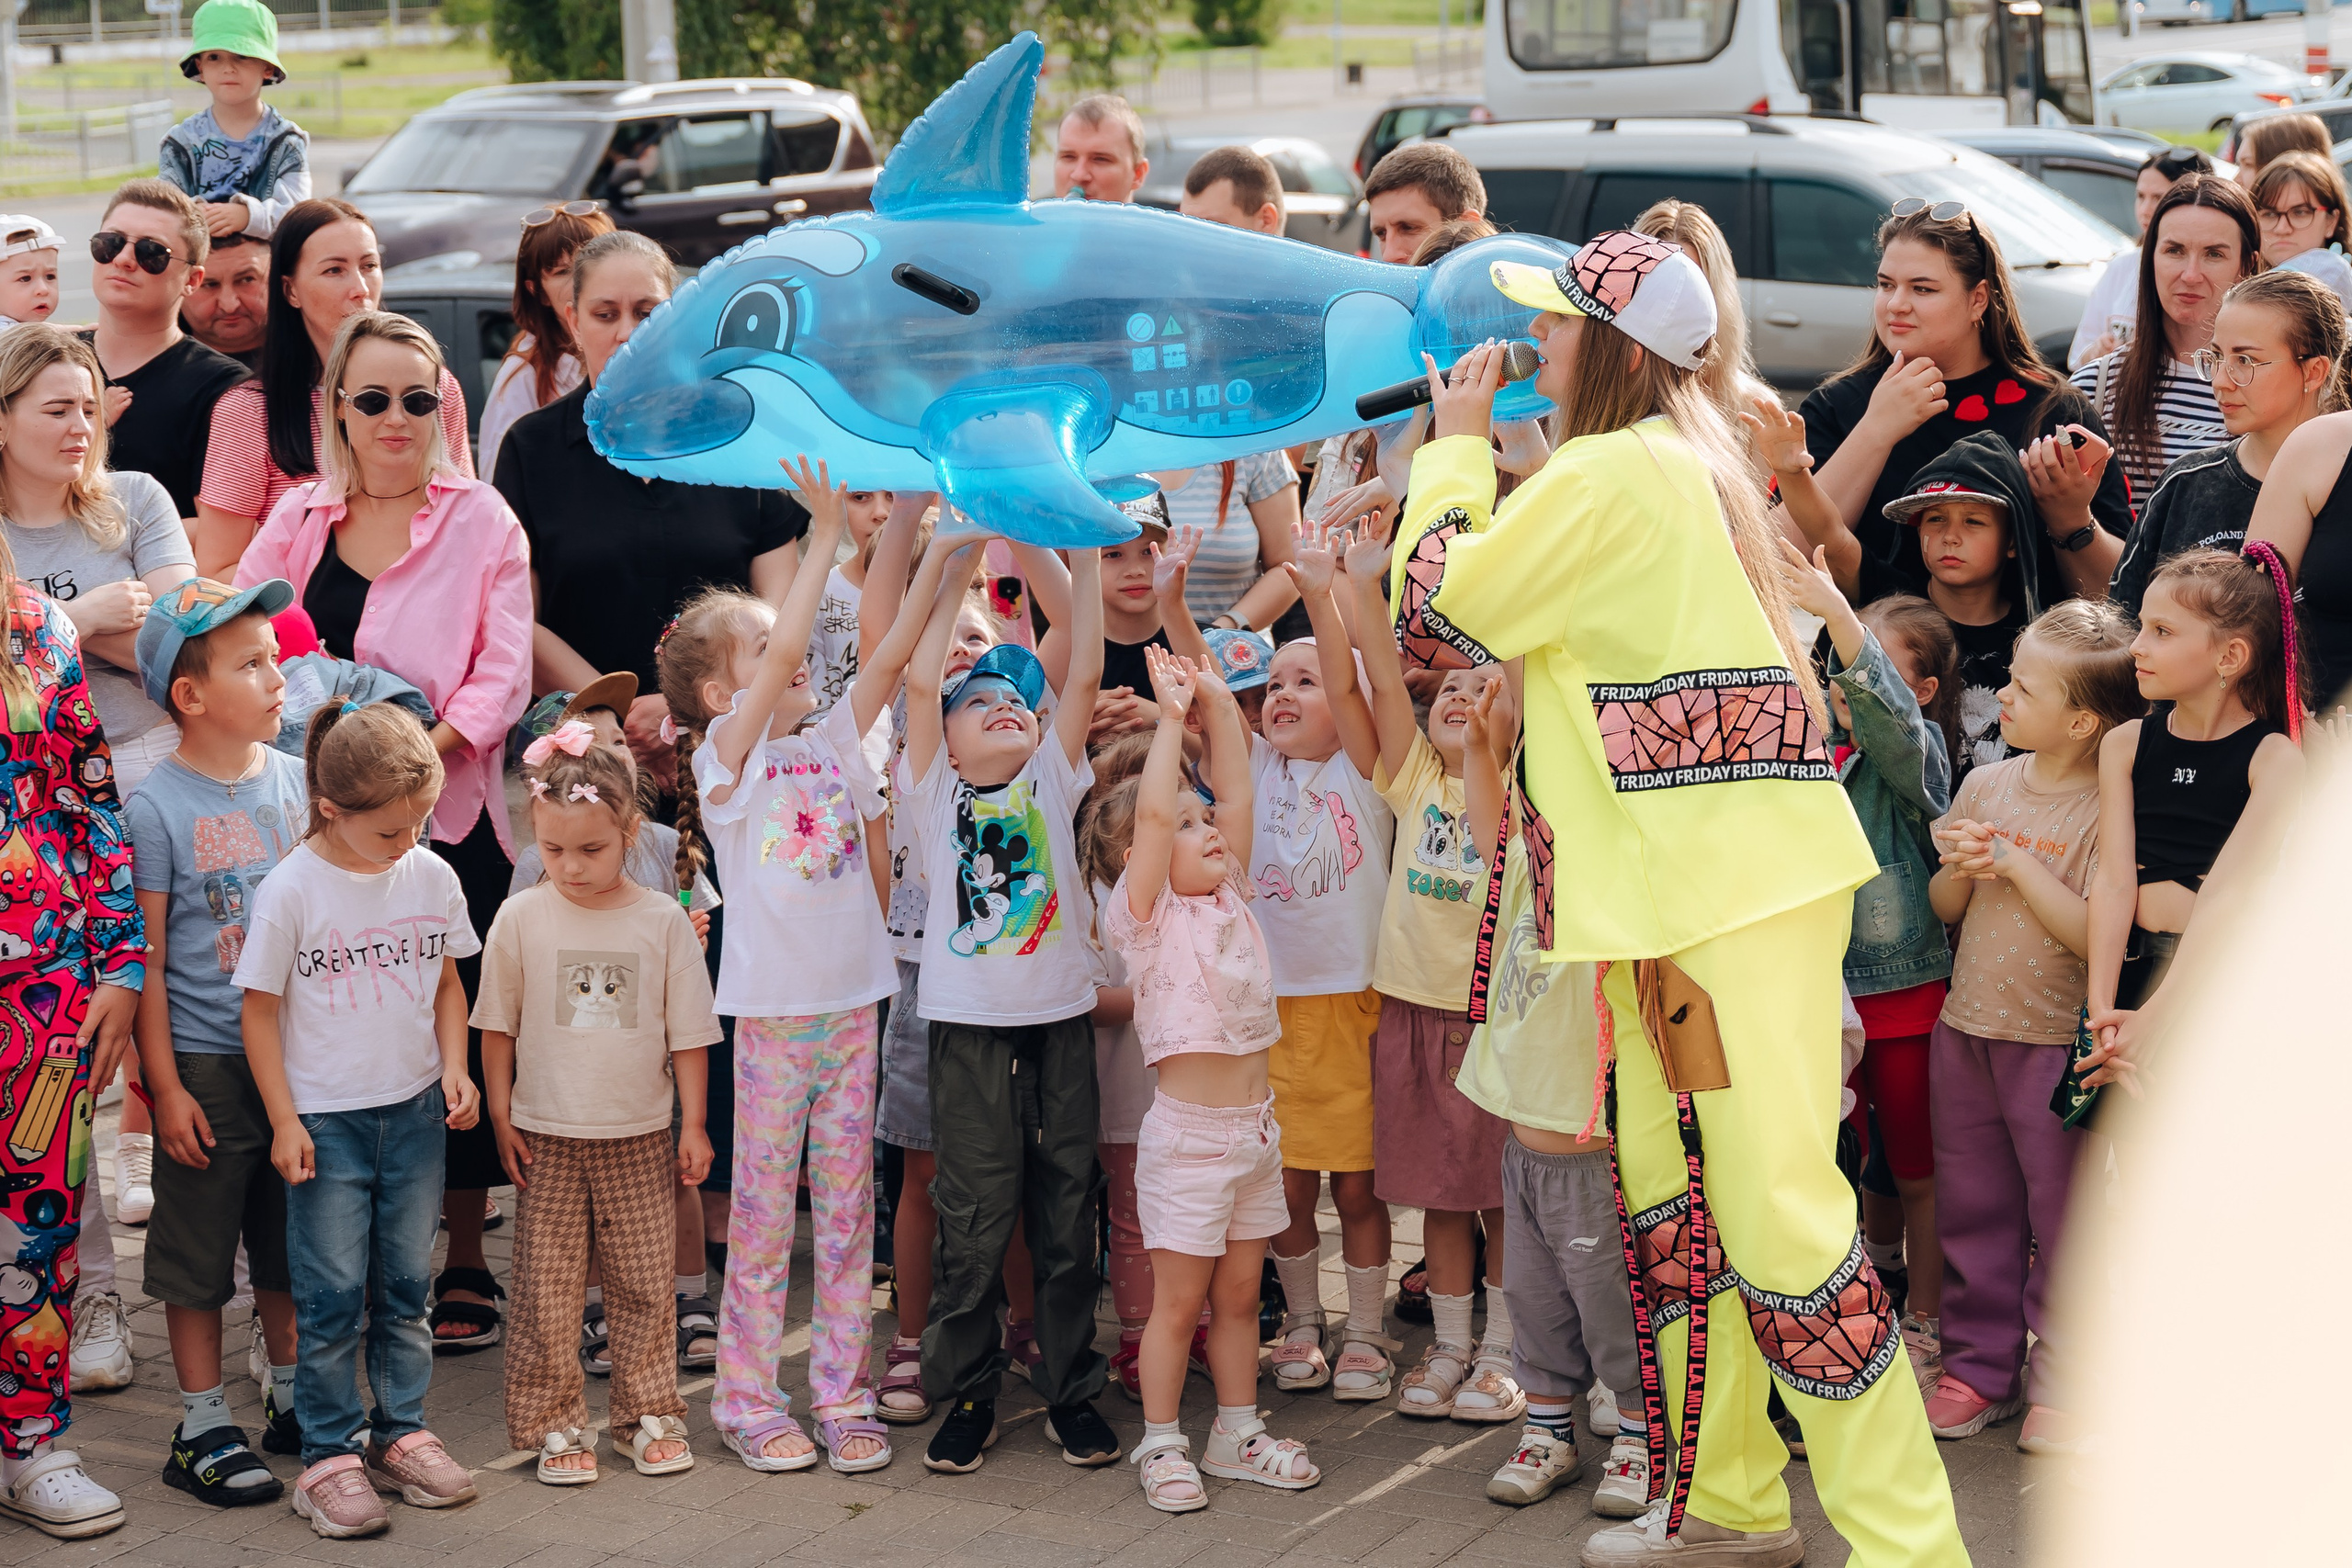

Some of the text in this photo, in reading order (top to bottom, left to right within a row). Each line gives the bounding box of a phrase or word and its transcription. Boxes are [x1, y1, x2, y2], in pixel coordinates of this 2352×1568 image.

[1555, 264, 1614, 321] RIDAY FRIDAY
[1421, 604, 1459, 641] FRIDAY
[1453, 635, 1498, 666] FRIDA
[1600, 686, 1652, 700] FRIDAY
[1699, 671, 1748, 686] FRIDAY
[1750, 668, 1797, 683] FRIDA
[1621, 772, 1674, 790] FRIDAY
[1676, 766, 1730, 784] FRIDAY
[1732, 762, 1788, 780] FRIDAY
[1790, 764, 1838, 780] FRIDA
[2014, 831, 2031, 849] be
[2036, 836, 2067, 857] kind
[298, 931, 447, 977] CREATIVE LIF
[321, 915, 448, 1014] ART
[1635, 1203, 1679, 1230] FRIDAY
[1739, 1278, 1783, 1309] FRIDAY
[1827, 1246, 1862, 1294] FRIDAY
[1772, 1360, 1815, 1393] FRIDAY
[1864, 1335, 1899, 1382] FRIDAY
